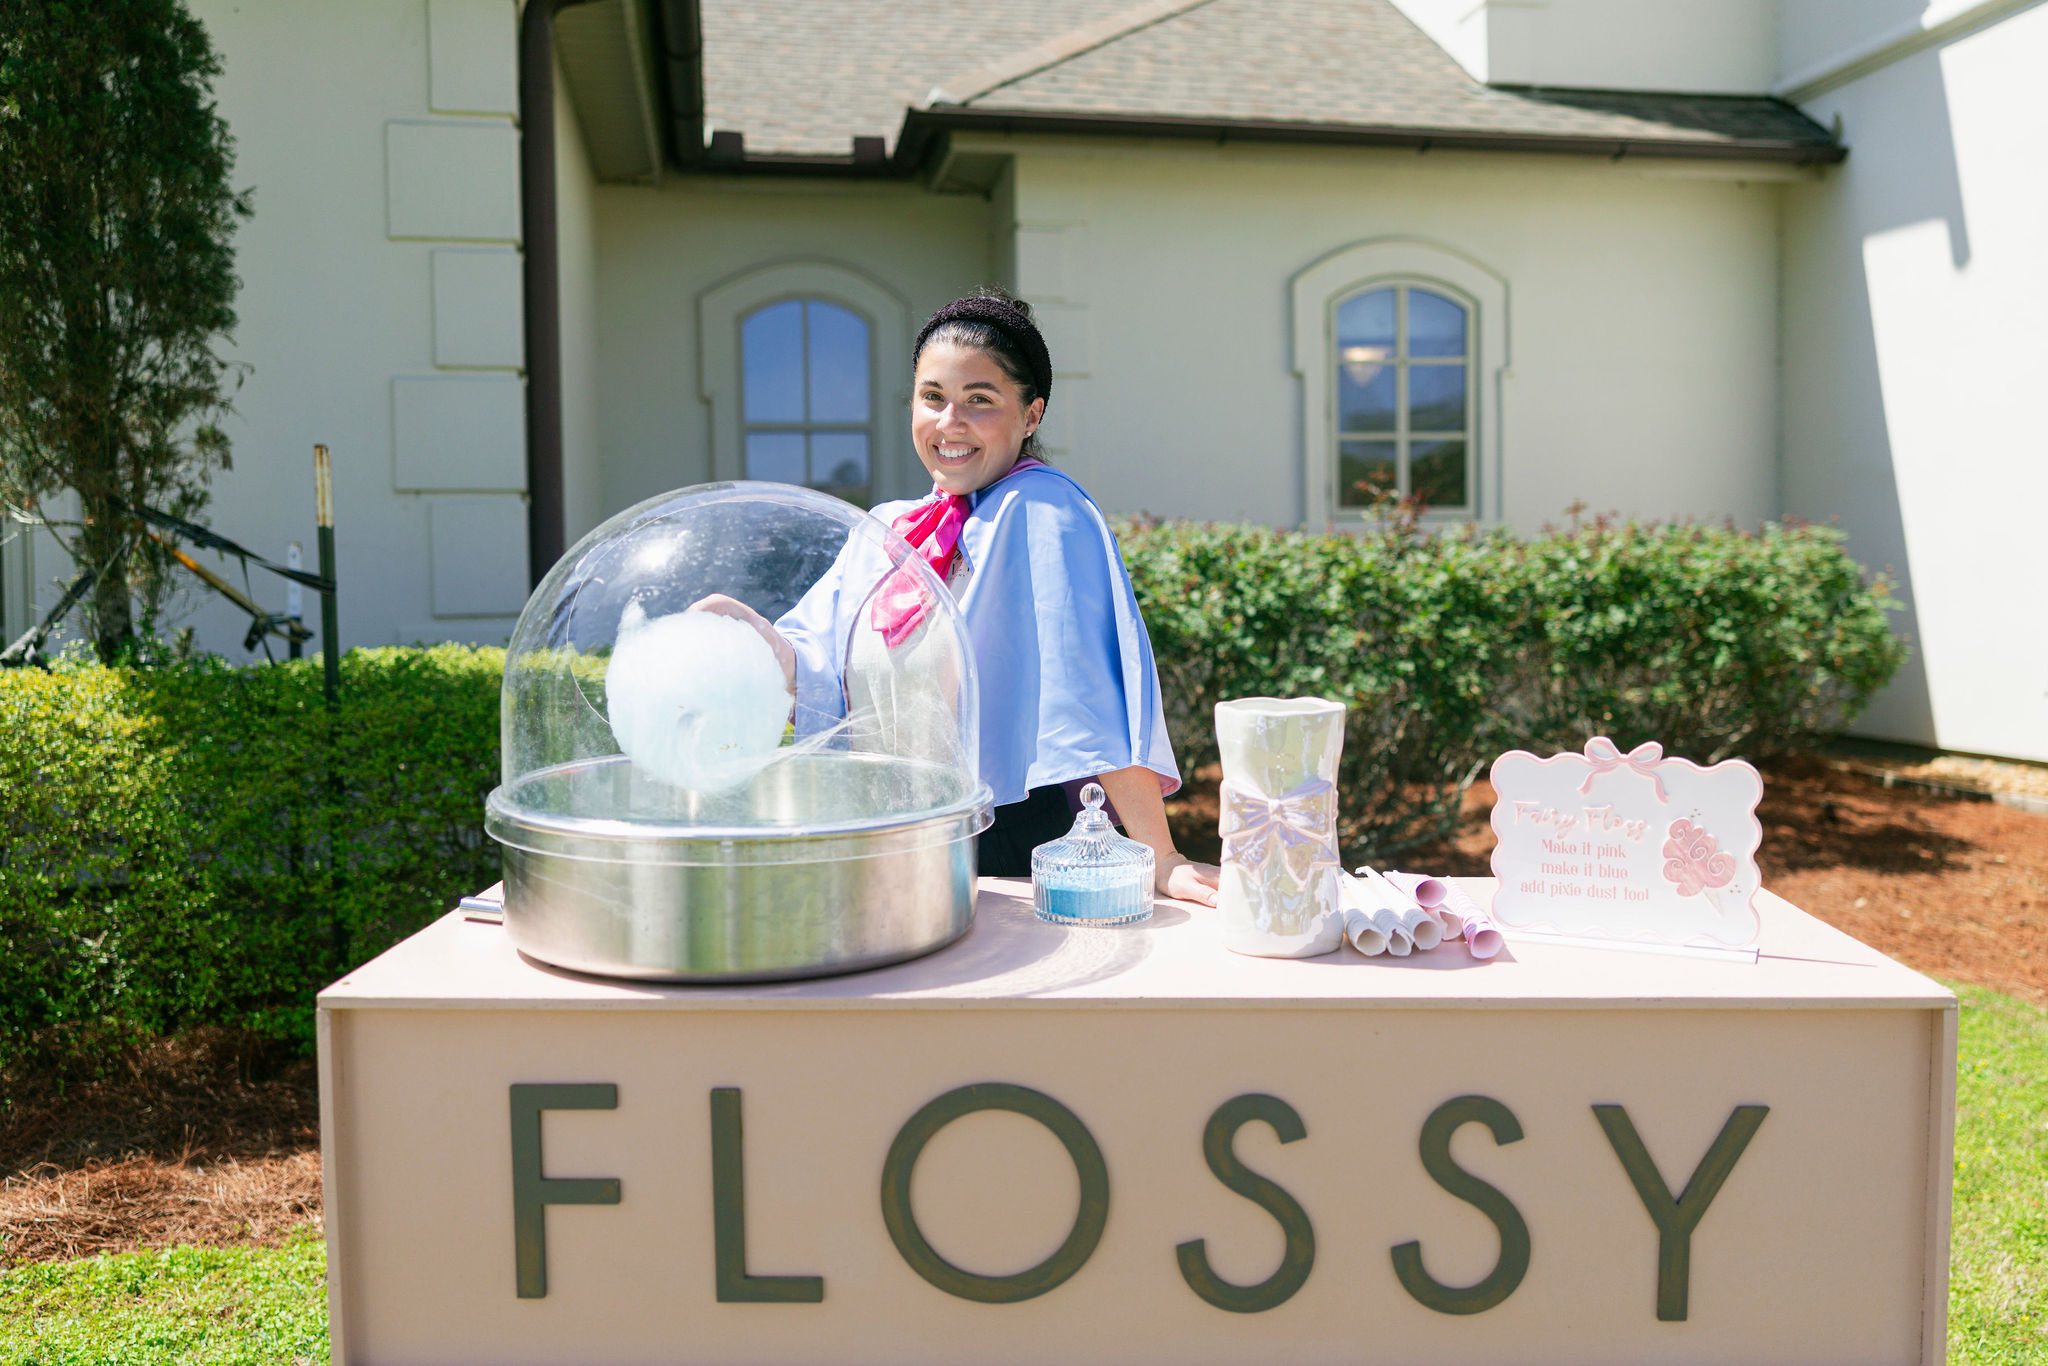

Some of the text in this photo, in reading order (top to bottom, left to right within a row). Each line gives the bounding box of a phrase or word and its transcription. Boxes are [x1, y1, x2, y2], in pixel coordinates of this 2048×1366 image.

[1541, 839, 1626, 860] Make it pink
[1541, 861, 1629, 879] make it blue
[1520, 879, 1649, 901] add pixie dust too!
[510, 1082, 1770, 1322] FLOSSY
